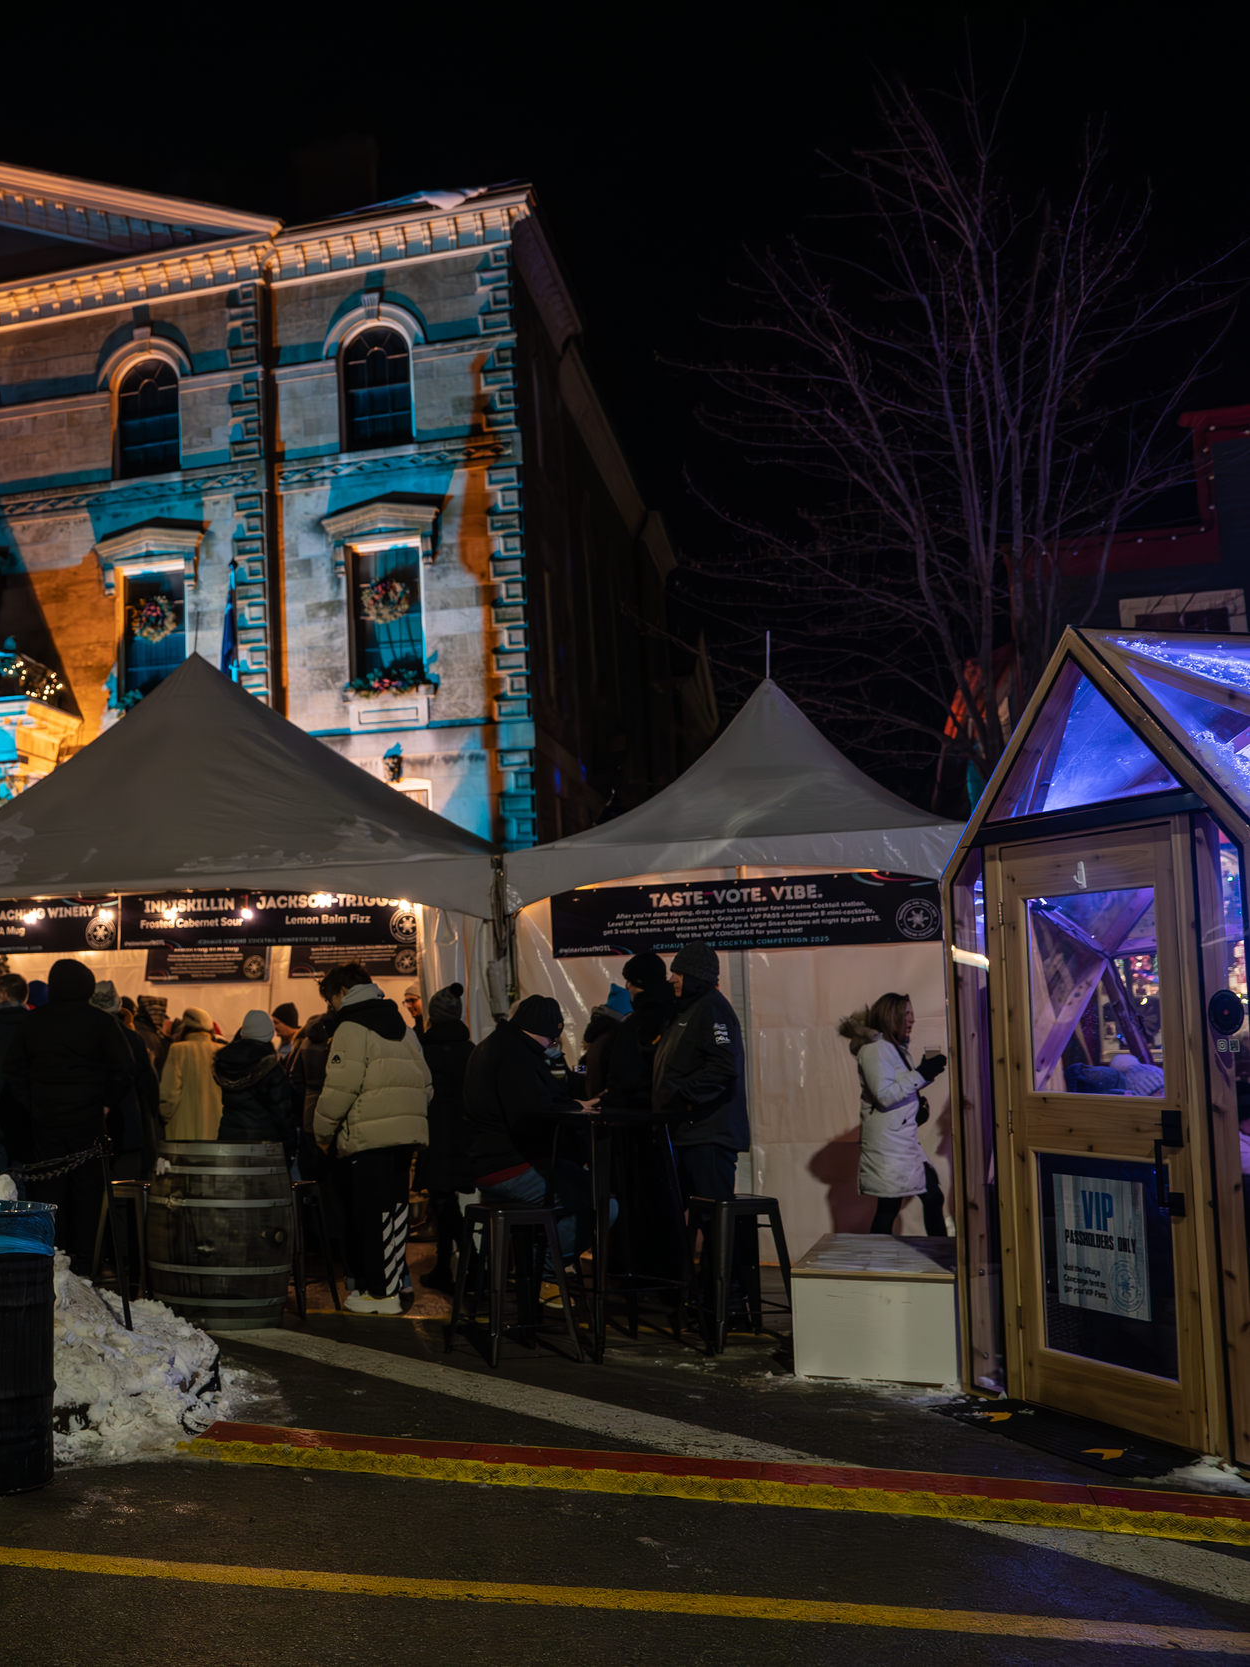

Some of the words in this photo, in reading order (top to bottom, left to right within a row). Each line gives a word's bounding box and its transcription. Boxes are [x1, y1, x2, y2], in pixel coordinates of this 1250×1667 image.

[649, 891, 710, 908] TASTE.
[713, 886, 768, 905] VOTE.
[771, 884, 824, 901] VIBE.
[47, 904, 97, 919] WINERY
[695, 909, 711, 917] drop
[140, 918, 175, 929] Frosted
[176, 917, 219, 928] Cabernet
[220, 916, 244, 927] Sour
[285, 916, 319, 926] Lemon
[321, 914, 348, 925] Balm
[350, 913, 371, 924] Fizz
[718, 939, 754, 947] COCKTAIL
[756, 937, 808, 945] COMPETITION
[1081, 1190, 1114, 1232] VIP
[1065, 1229, 1114, 1251] PASSHOLDERS
[1117, 1237, 1137, 1254] ONLY
